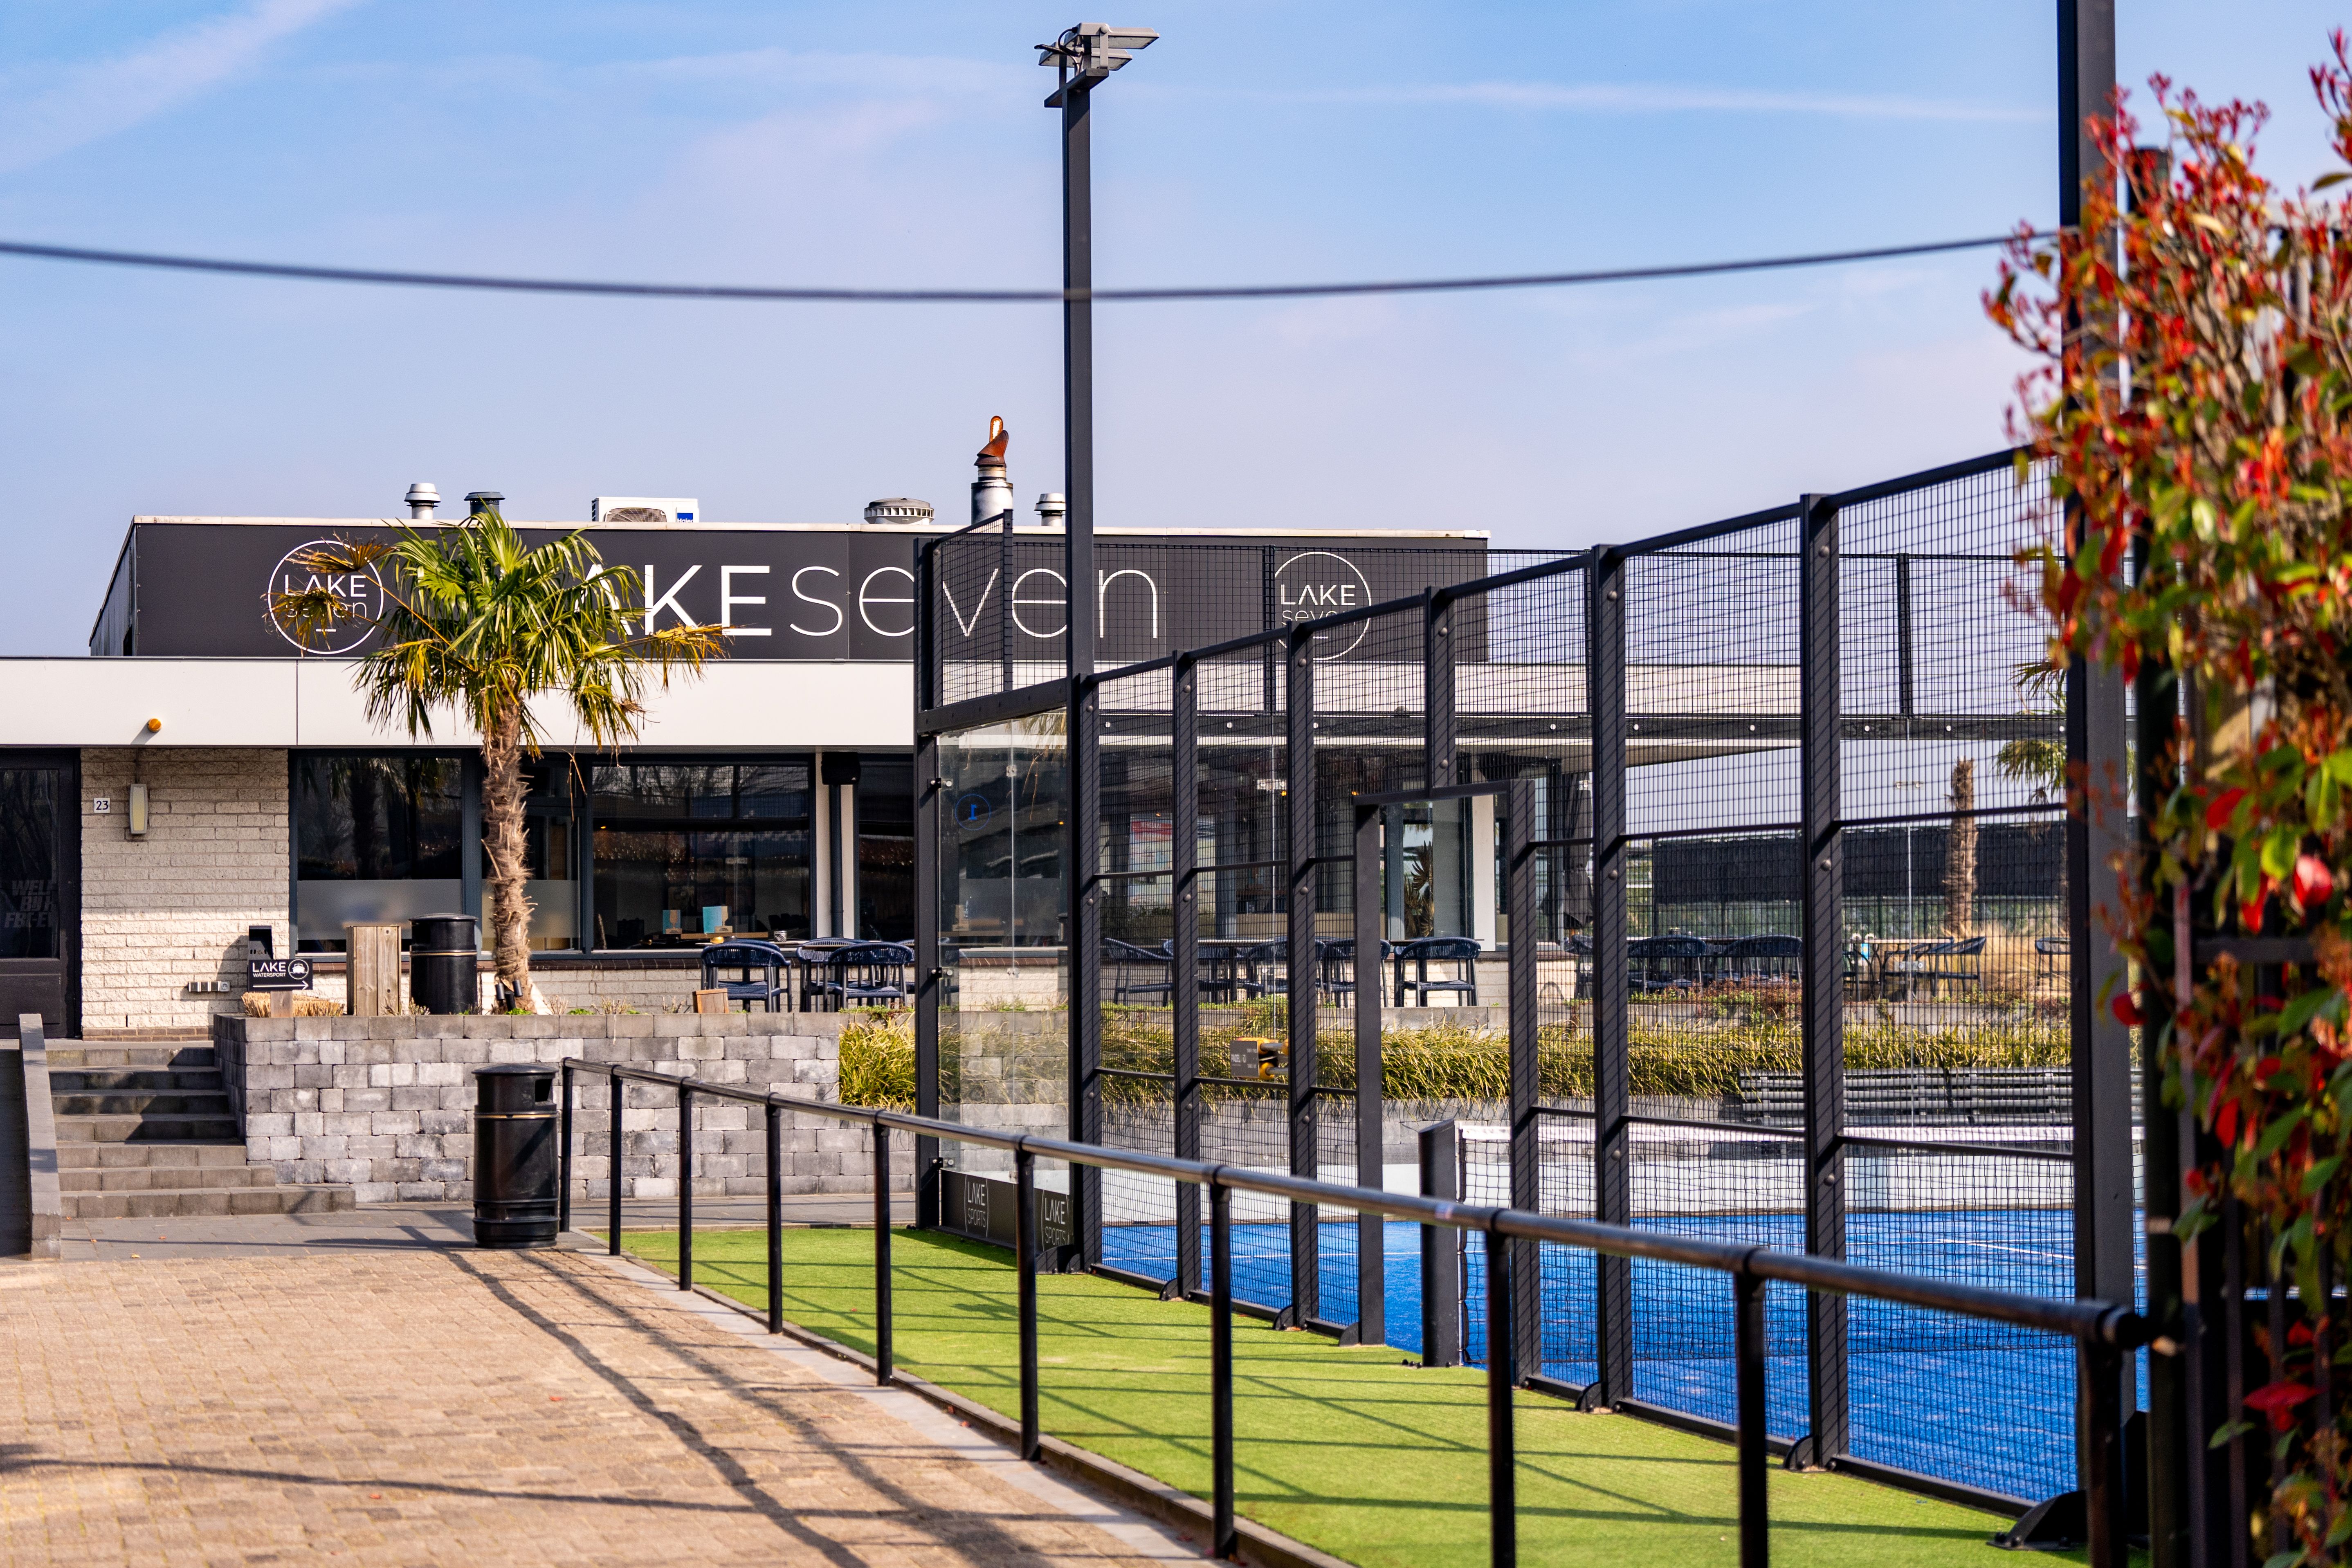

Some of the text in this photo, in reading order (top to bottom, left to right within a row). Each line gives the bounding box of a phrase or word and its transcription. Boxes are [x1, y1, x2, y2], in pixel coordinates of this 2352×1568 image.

[285, 574, 366, 597] LAKE
[1281, 584, 1355, 606] LAKE
[563, 564, 772, 636] AKE
[96, 800, 108, 810] 23
[252, 962, 286, 972] LAKE
[968, 1182, 985, 1206] LAKE
[968, 1208, 986, 1228] SPORTS
[1045, 1198, 1065, 1225] LAKE
[1045, 1226, 1066, 1247] SPORTS
